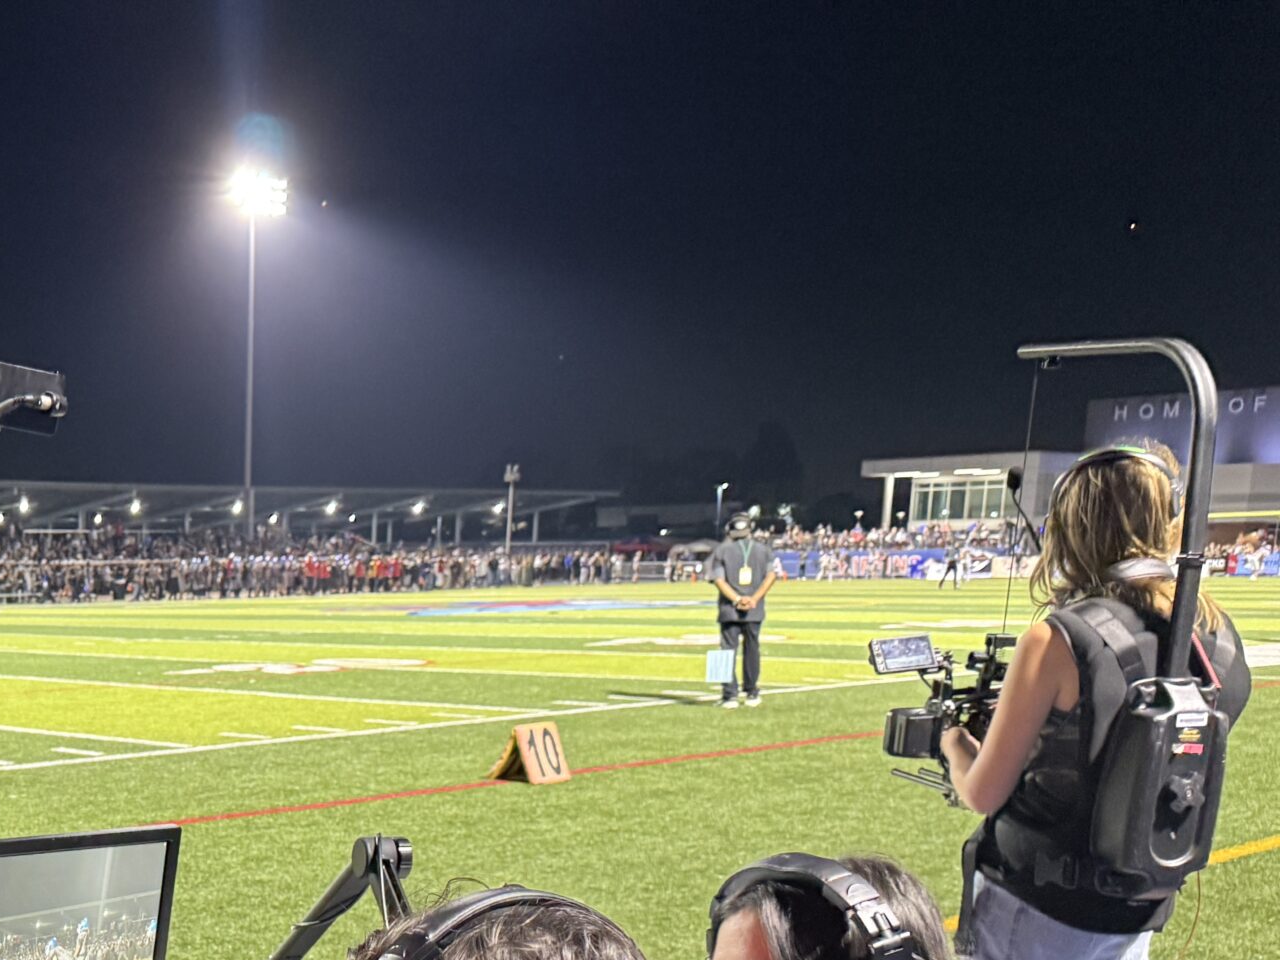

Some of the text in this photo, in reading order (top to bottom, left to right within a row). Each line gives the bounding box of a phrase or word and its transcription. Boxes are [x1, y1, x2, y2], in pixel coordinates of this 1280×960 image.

[1113, 395, 1267, 422] HOM OF
[527, 727, 561, 778] 10
